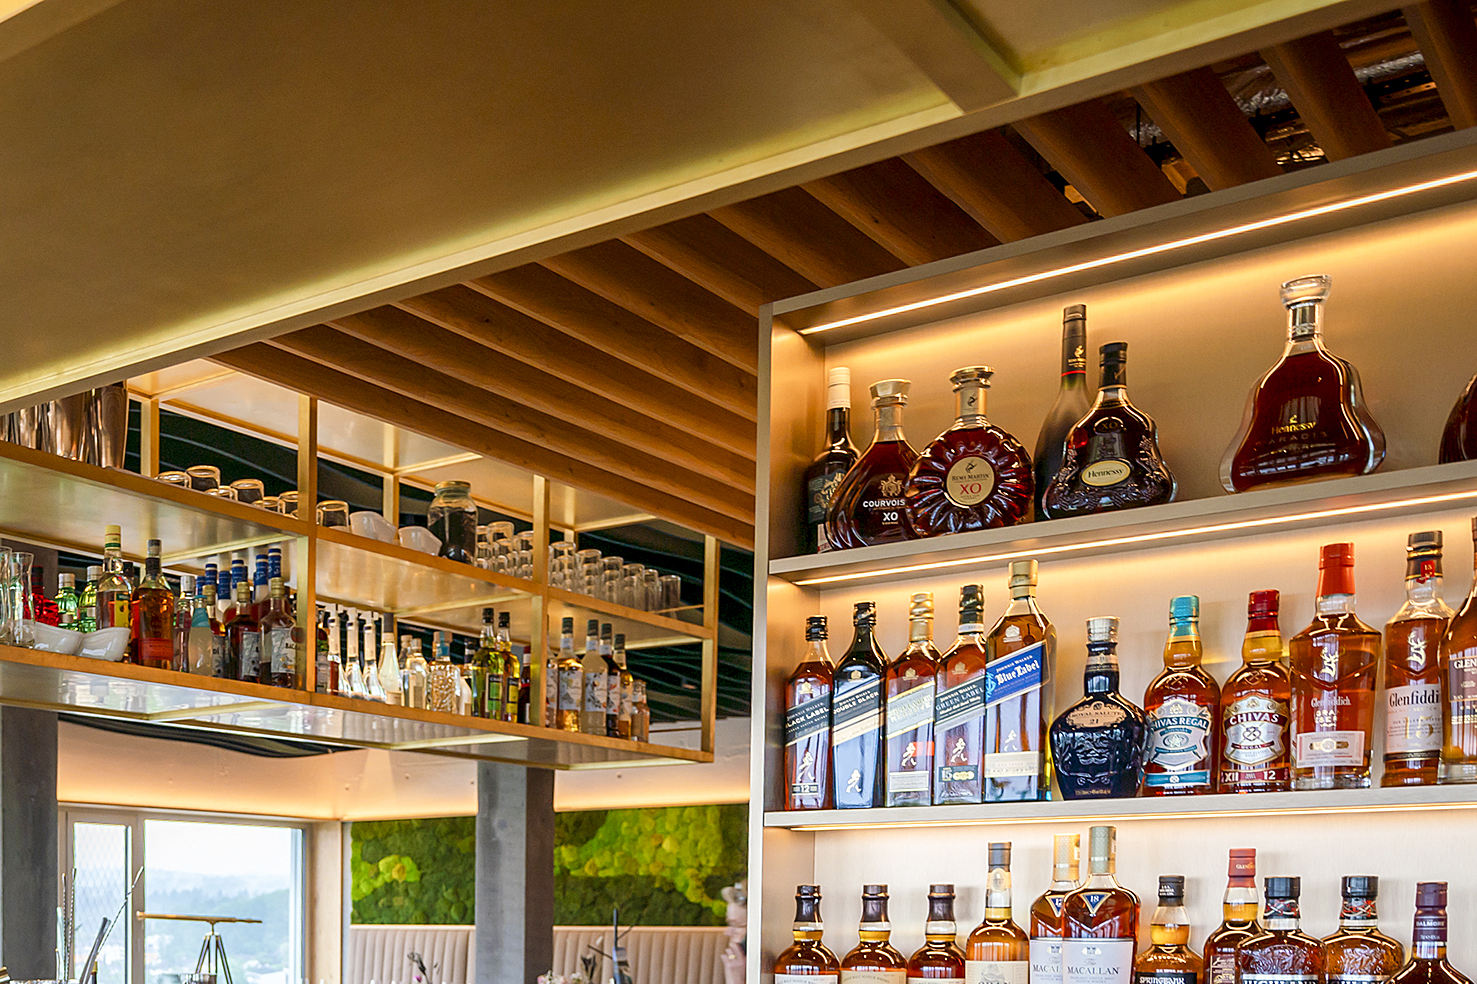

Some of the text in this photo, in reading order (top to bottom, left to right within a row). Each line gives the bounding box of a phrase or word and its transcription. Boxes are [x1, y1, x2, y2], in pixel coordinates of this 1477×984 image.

[1272, 421, 1316, 435] Hennessy
[1088, 468, 1124, 479] Hennessy
[959, 482, 982, 496] XO
[882, 511, 899, 522] XO
[995, 659, 1040, 685] Blue Label
[858, 692, 879, 703] BLACK
[935, 687, 984, 711] GREEN LABEL
[1389, 689, 1440, 707] Glenfiddi
[806, 706, 830, 720] LABEL
[1229, 712, 1280, 725] CHIVAS
[1178, 716, 1207, 729] REGAL
[1224, 772, 1239, 782] XII
[1263, 770, 1276, 780] 12
[800, 784, 810, 793] 12
[1090, 895, 1099, 903] 18
[1067, 966, 1120, 975] MACALLAN
